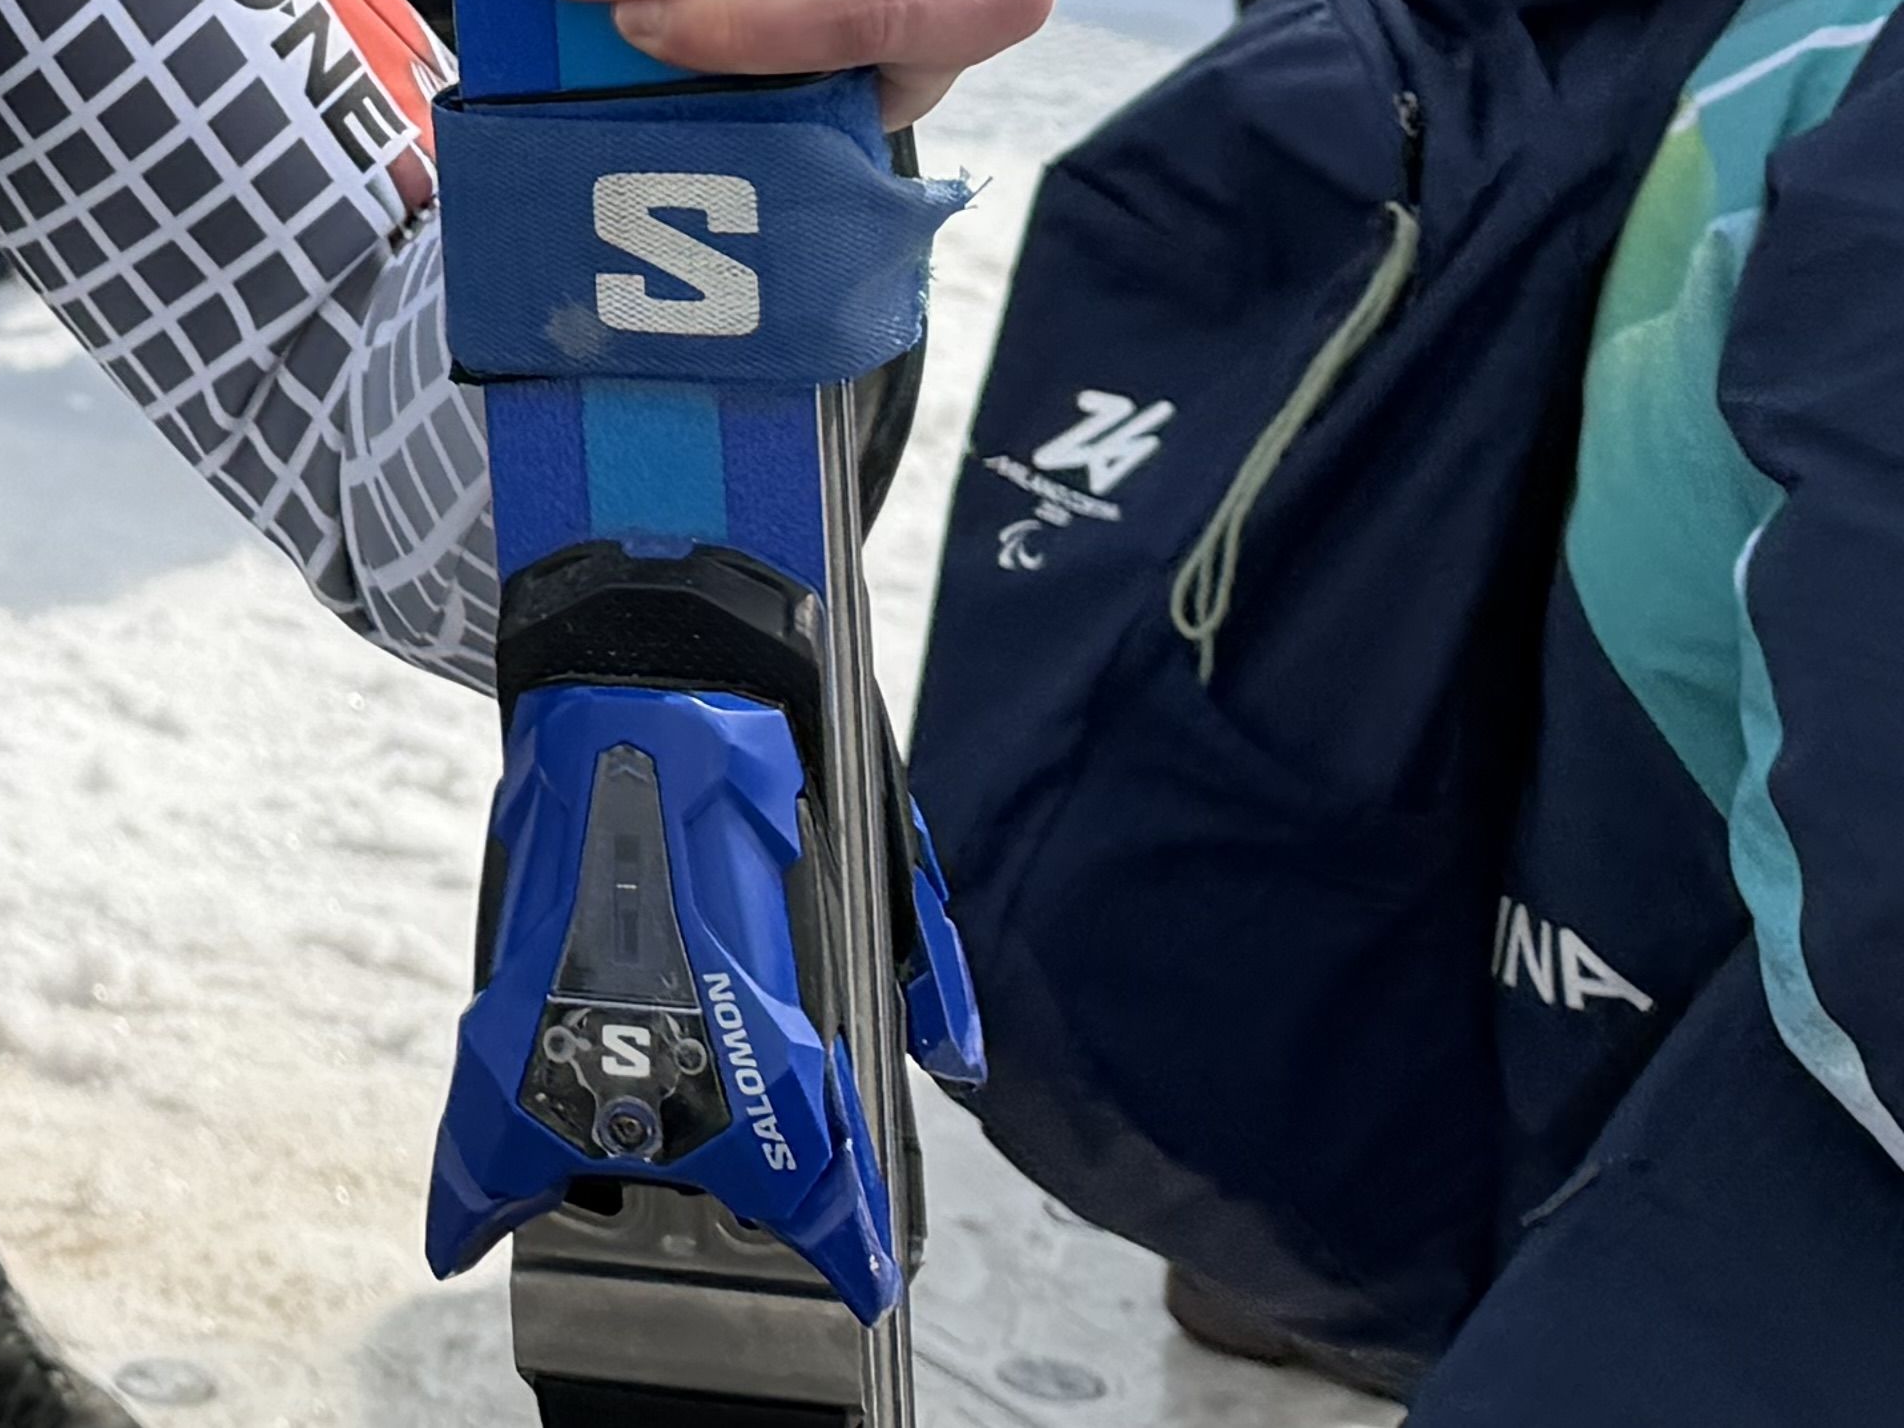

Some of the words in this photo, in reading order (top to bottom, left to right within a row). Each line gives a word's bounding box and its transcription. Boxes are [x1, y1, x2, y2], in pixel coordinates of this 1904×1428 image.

[593, 172, 759, 336] S
[602, 1024, 651, 1078] S
[703, 973, 797, 1171] SALOMON
